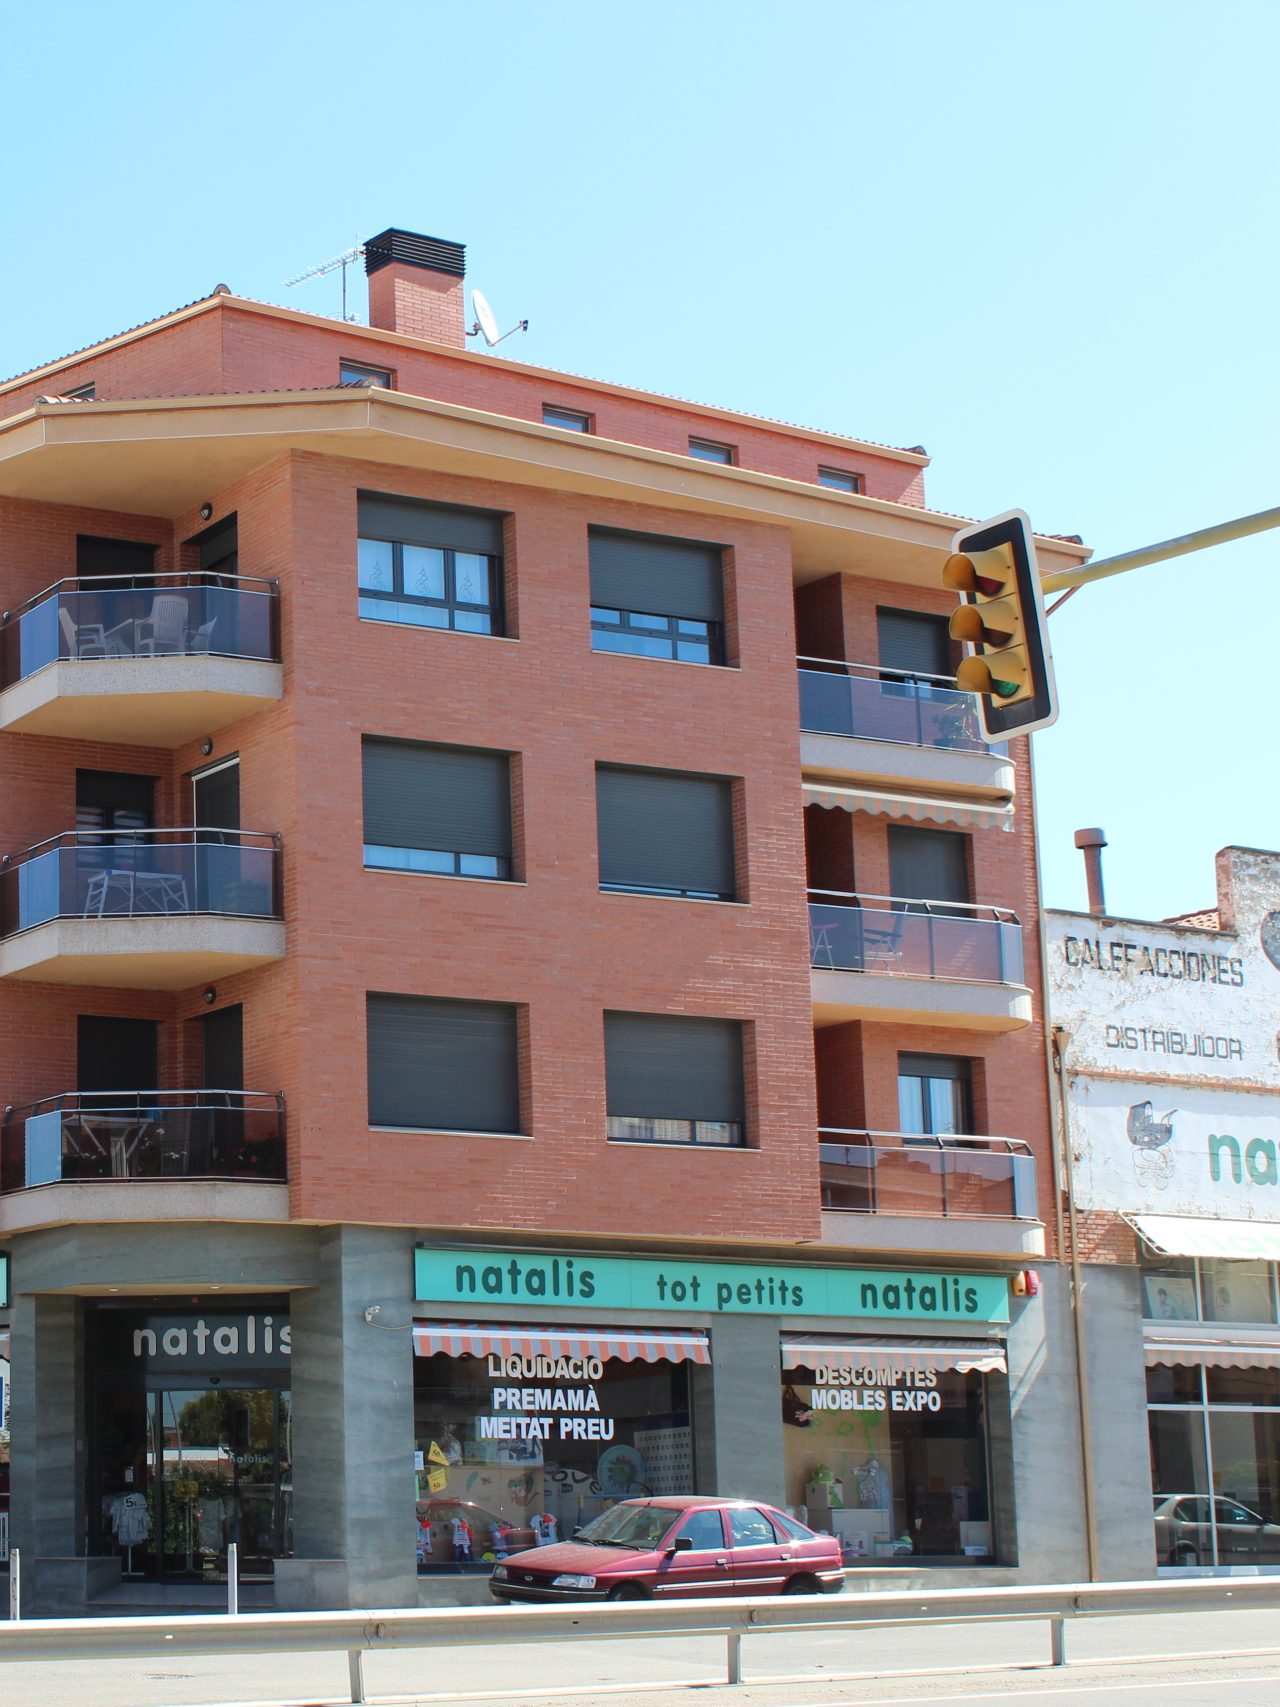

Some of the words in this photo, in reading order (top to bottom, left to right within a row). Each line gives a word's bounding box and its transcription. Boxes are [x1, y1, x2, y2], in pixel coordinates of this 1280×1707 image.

[1064, 936, 1243, 988] CALEFACCIONES
[1106, 1024, 1243, 1061] DISTRIBUIDOR
[1208, 1133, 1280, 1186] na
[456, 1259, 595, 1298] natalis
[657, 1274, 700, 1302] tot
[717, 1277, 804, 1311] petits
[861, 1277, 978, 1313] natalis
[815, 1365, 938, 1387] DESCOMPTES
[493, 1384, 600, 1411] PREMAMÀ
[811, 1389, 887, 1411] MOBLES
[891, 1390, 941, 1412] EXPO
[480, 1416, 554, 1439] MEITAT
[560, 1417, 614, 1440] PREU
